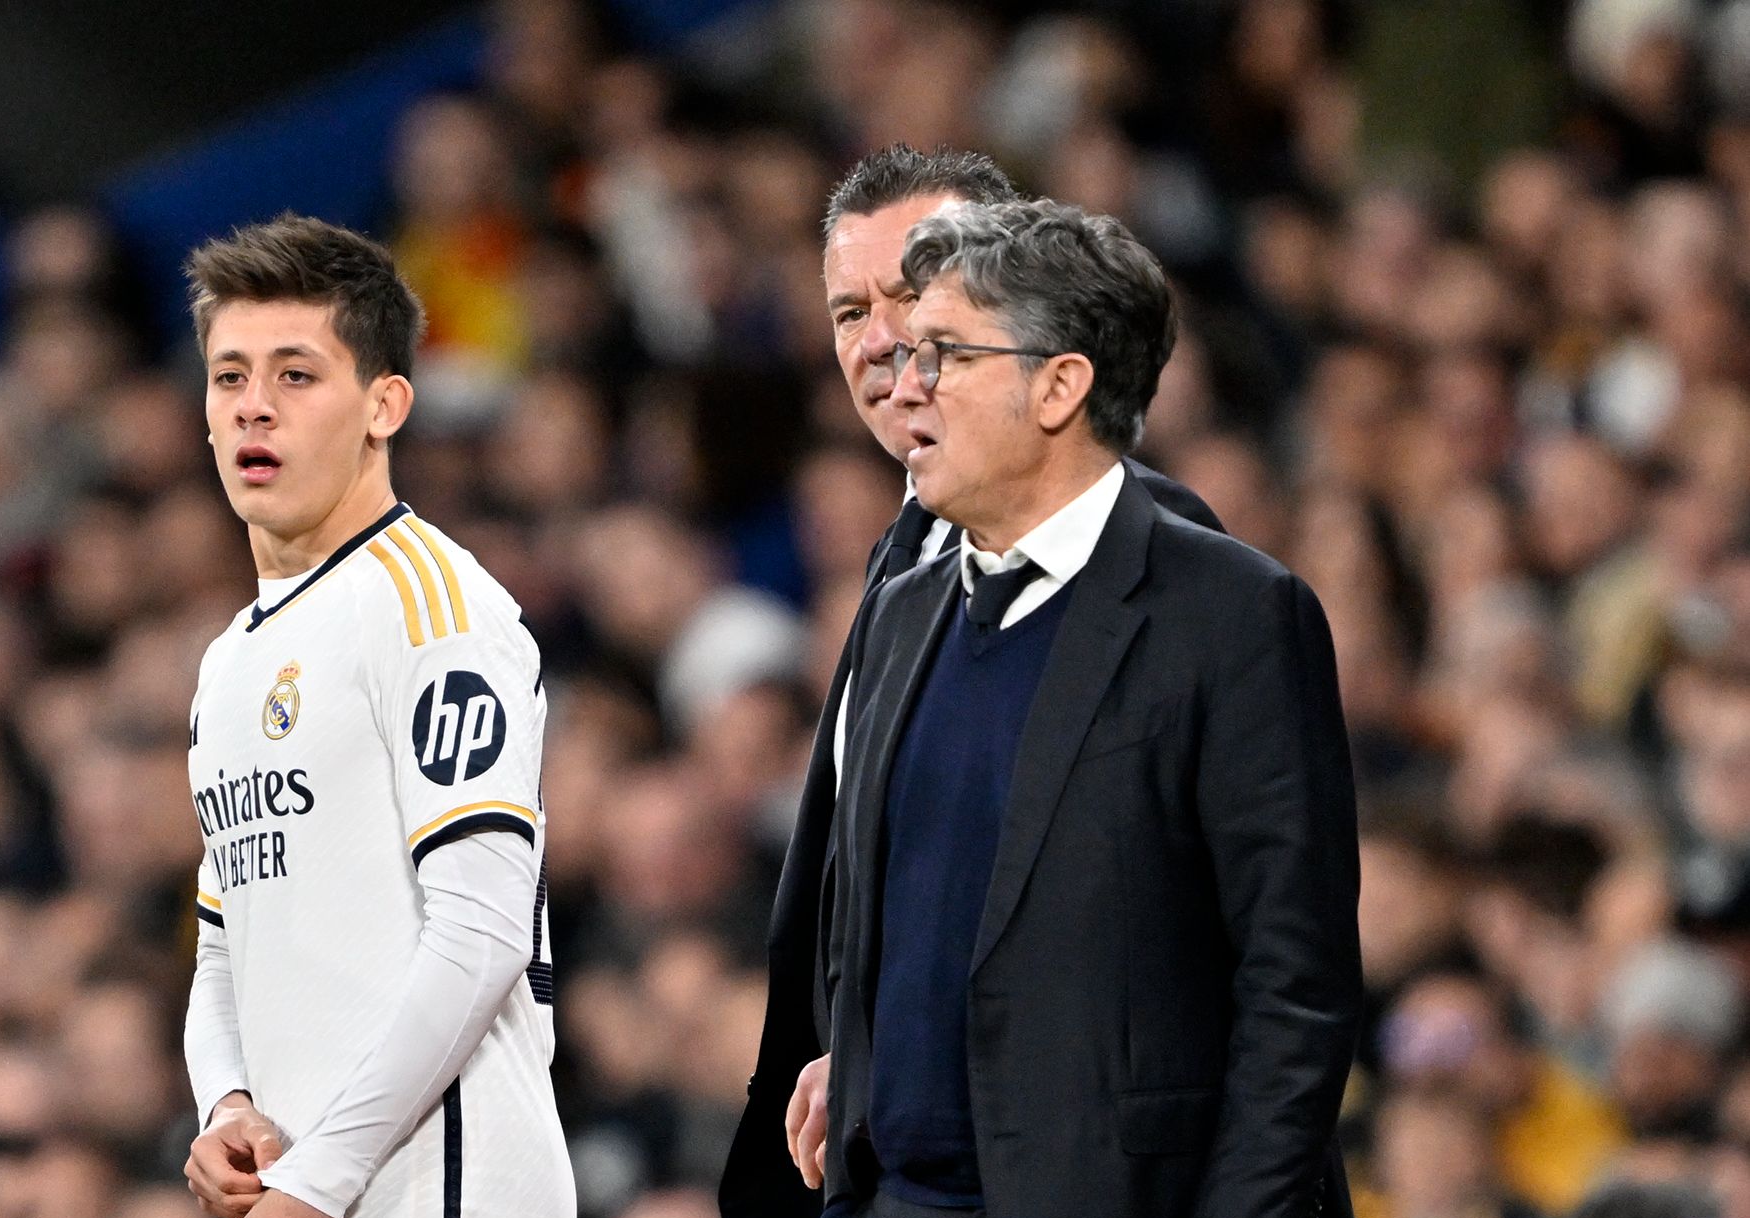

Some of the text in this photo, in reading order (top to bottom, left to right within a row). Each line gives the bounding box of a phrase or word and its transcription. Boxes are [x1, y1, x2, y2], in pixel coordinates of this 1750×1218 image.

[421, 671, 497, 783] hp
[193, 764, 315, 838] mirates
[230, 830, 288, 888] BETTER
